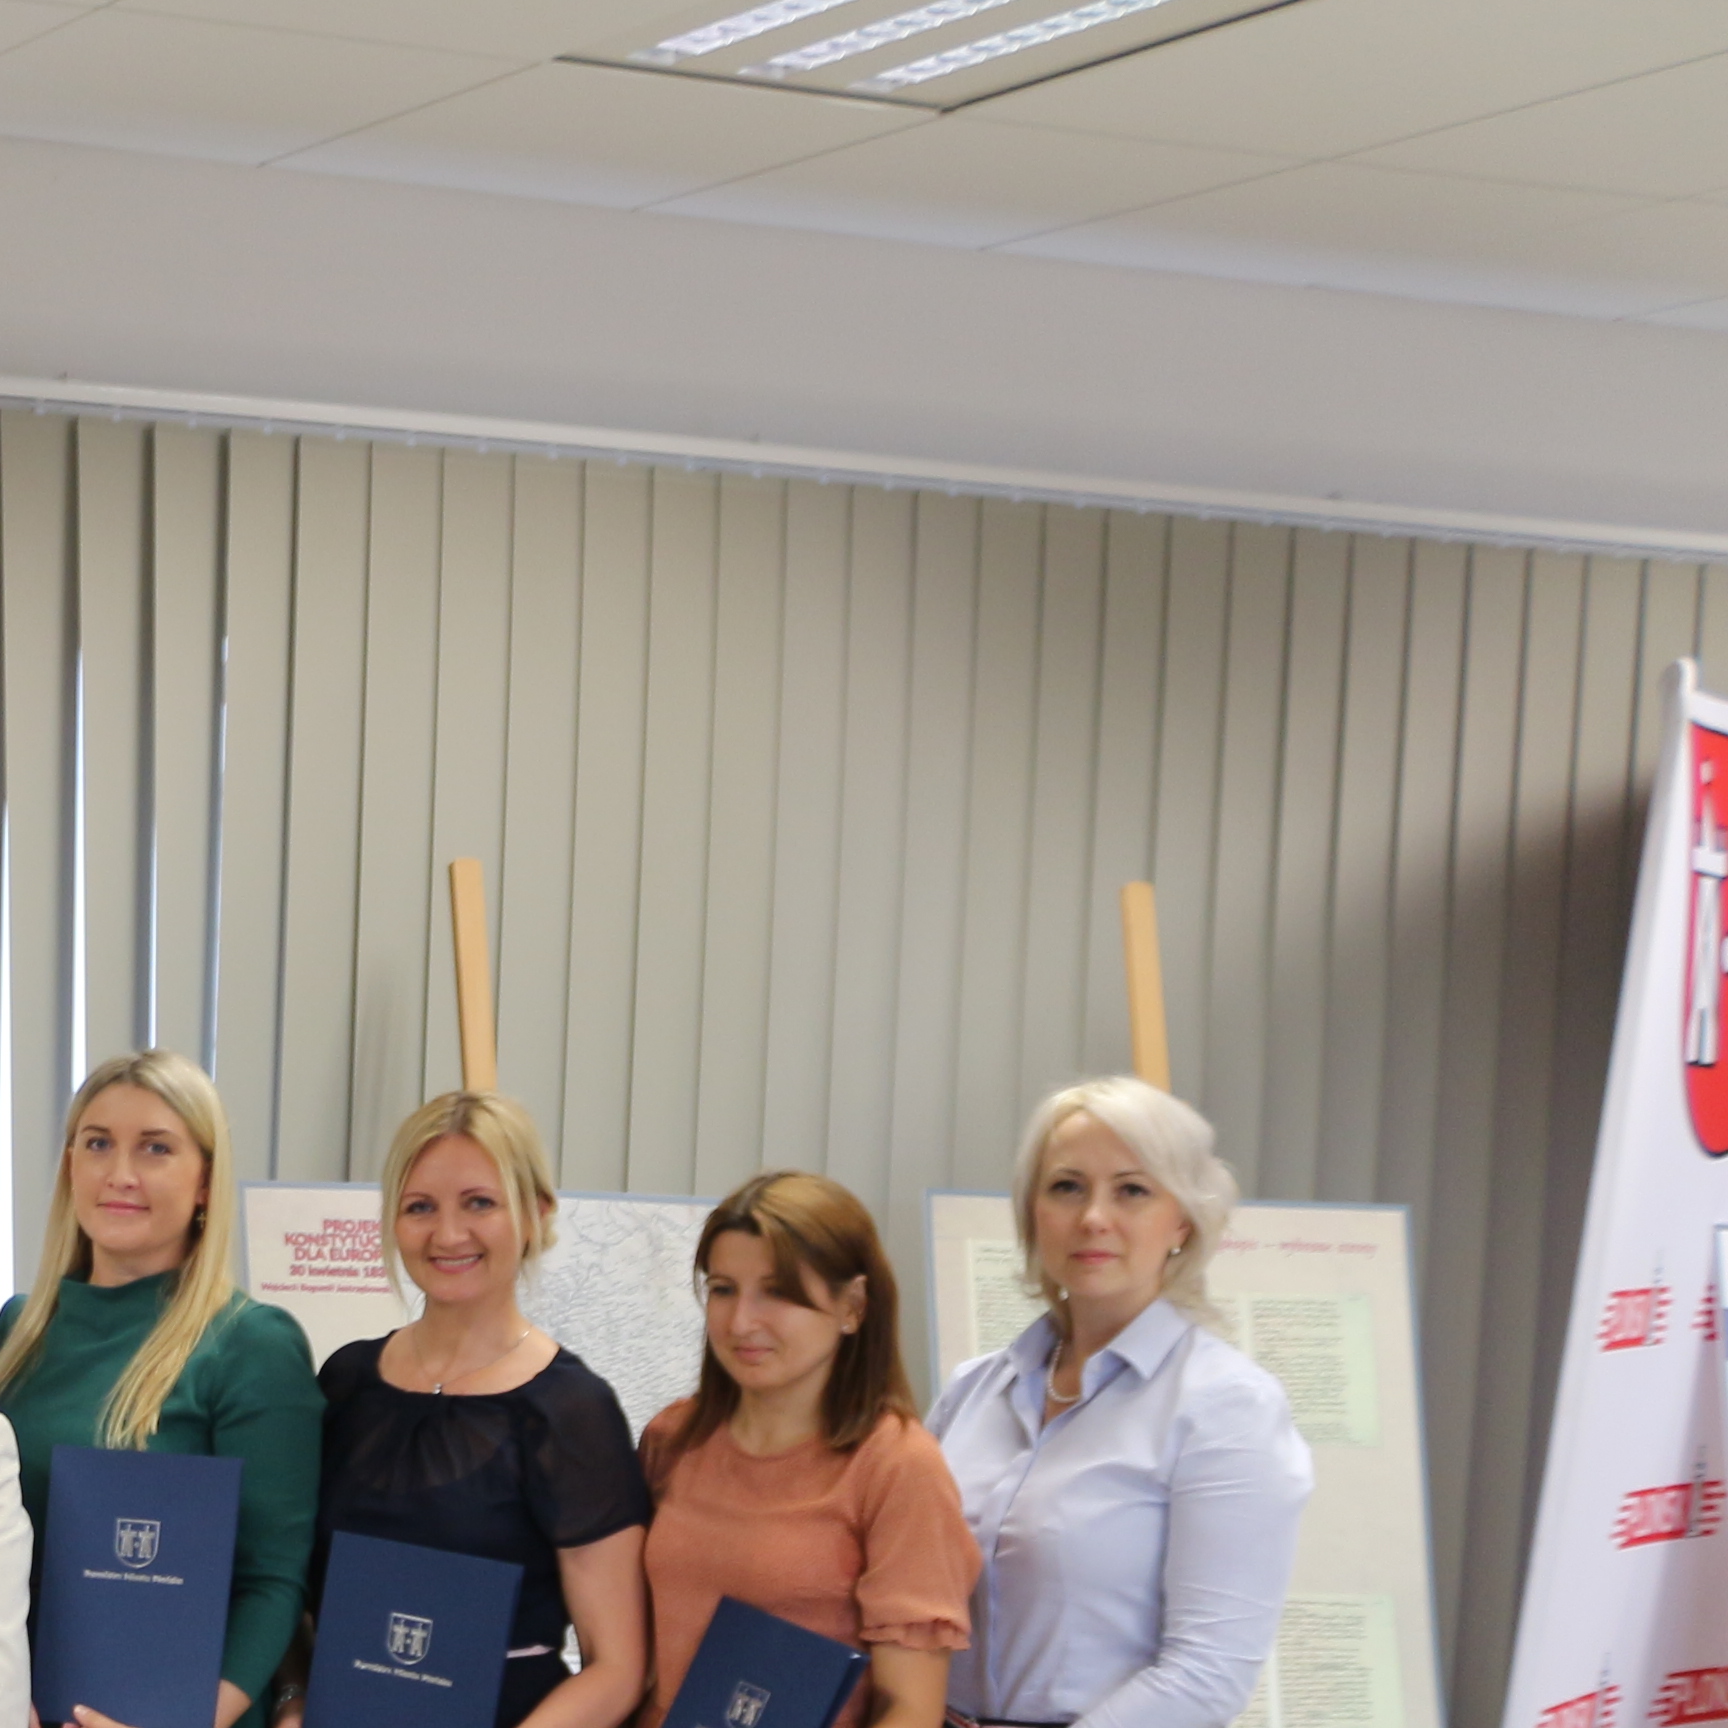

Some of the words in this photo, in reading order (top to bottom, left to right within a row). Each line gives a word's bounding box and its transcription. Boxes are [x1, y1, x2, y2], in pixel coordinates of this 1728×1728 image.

[323, 1219, 382, 1233] PROJEK
[285, 1233, 382, 1247] KONSTYTUC
[294, 1247, 325, 1261] DLA
[329, 1248, 382, 1262] EUROP
